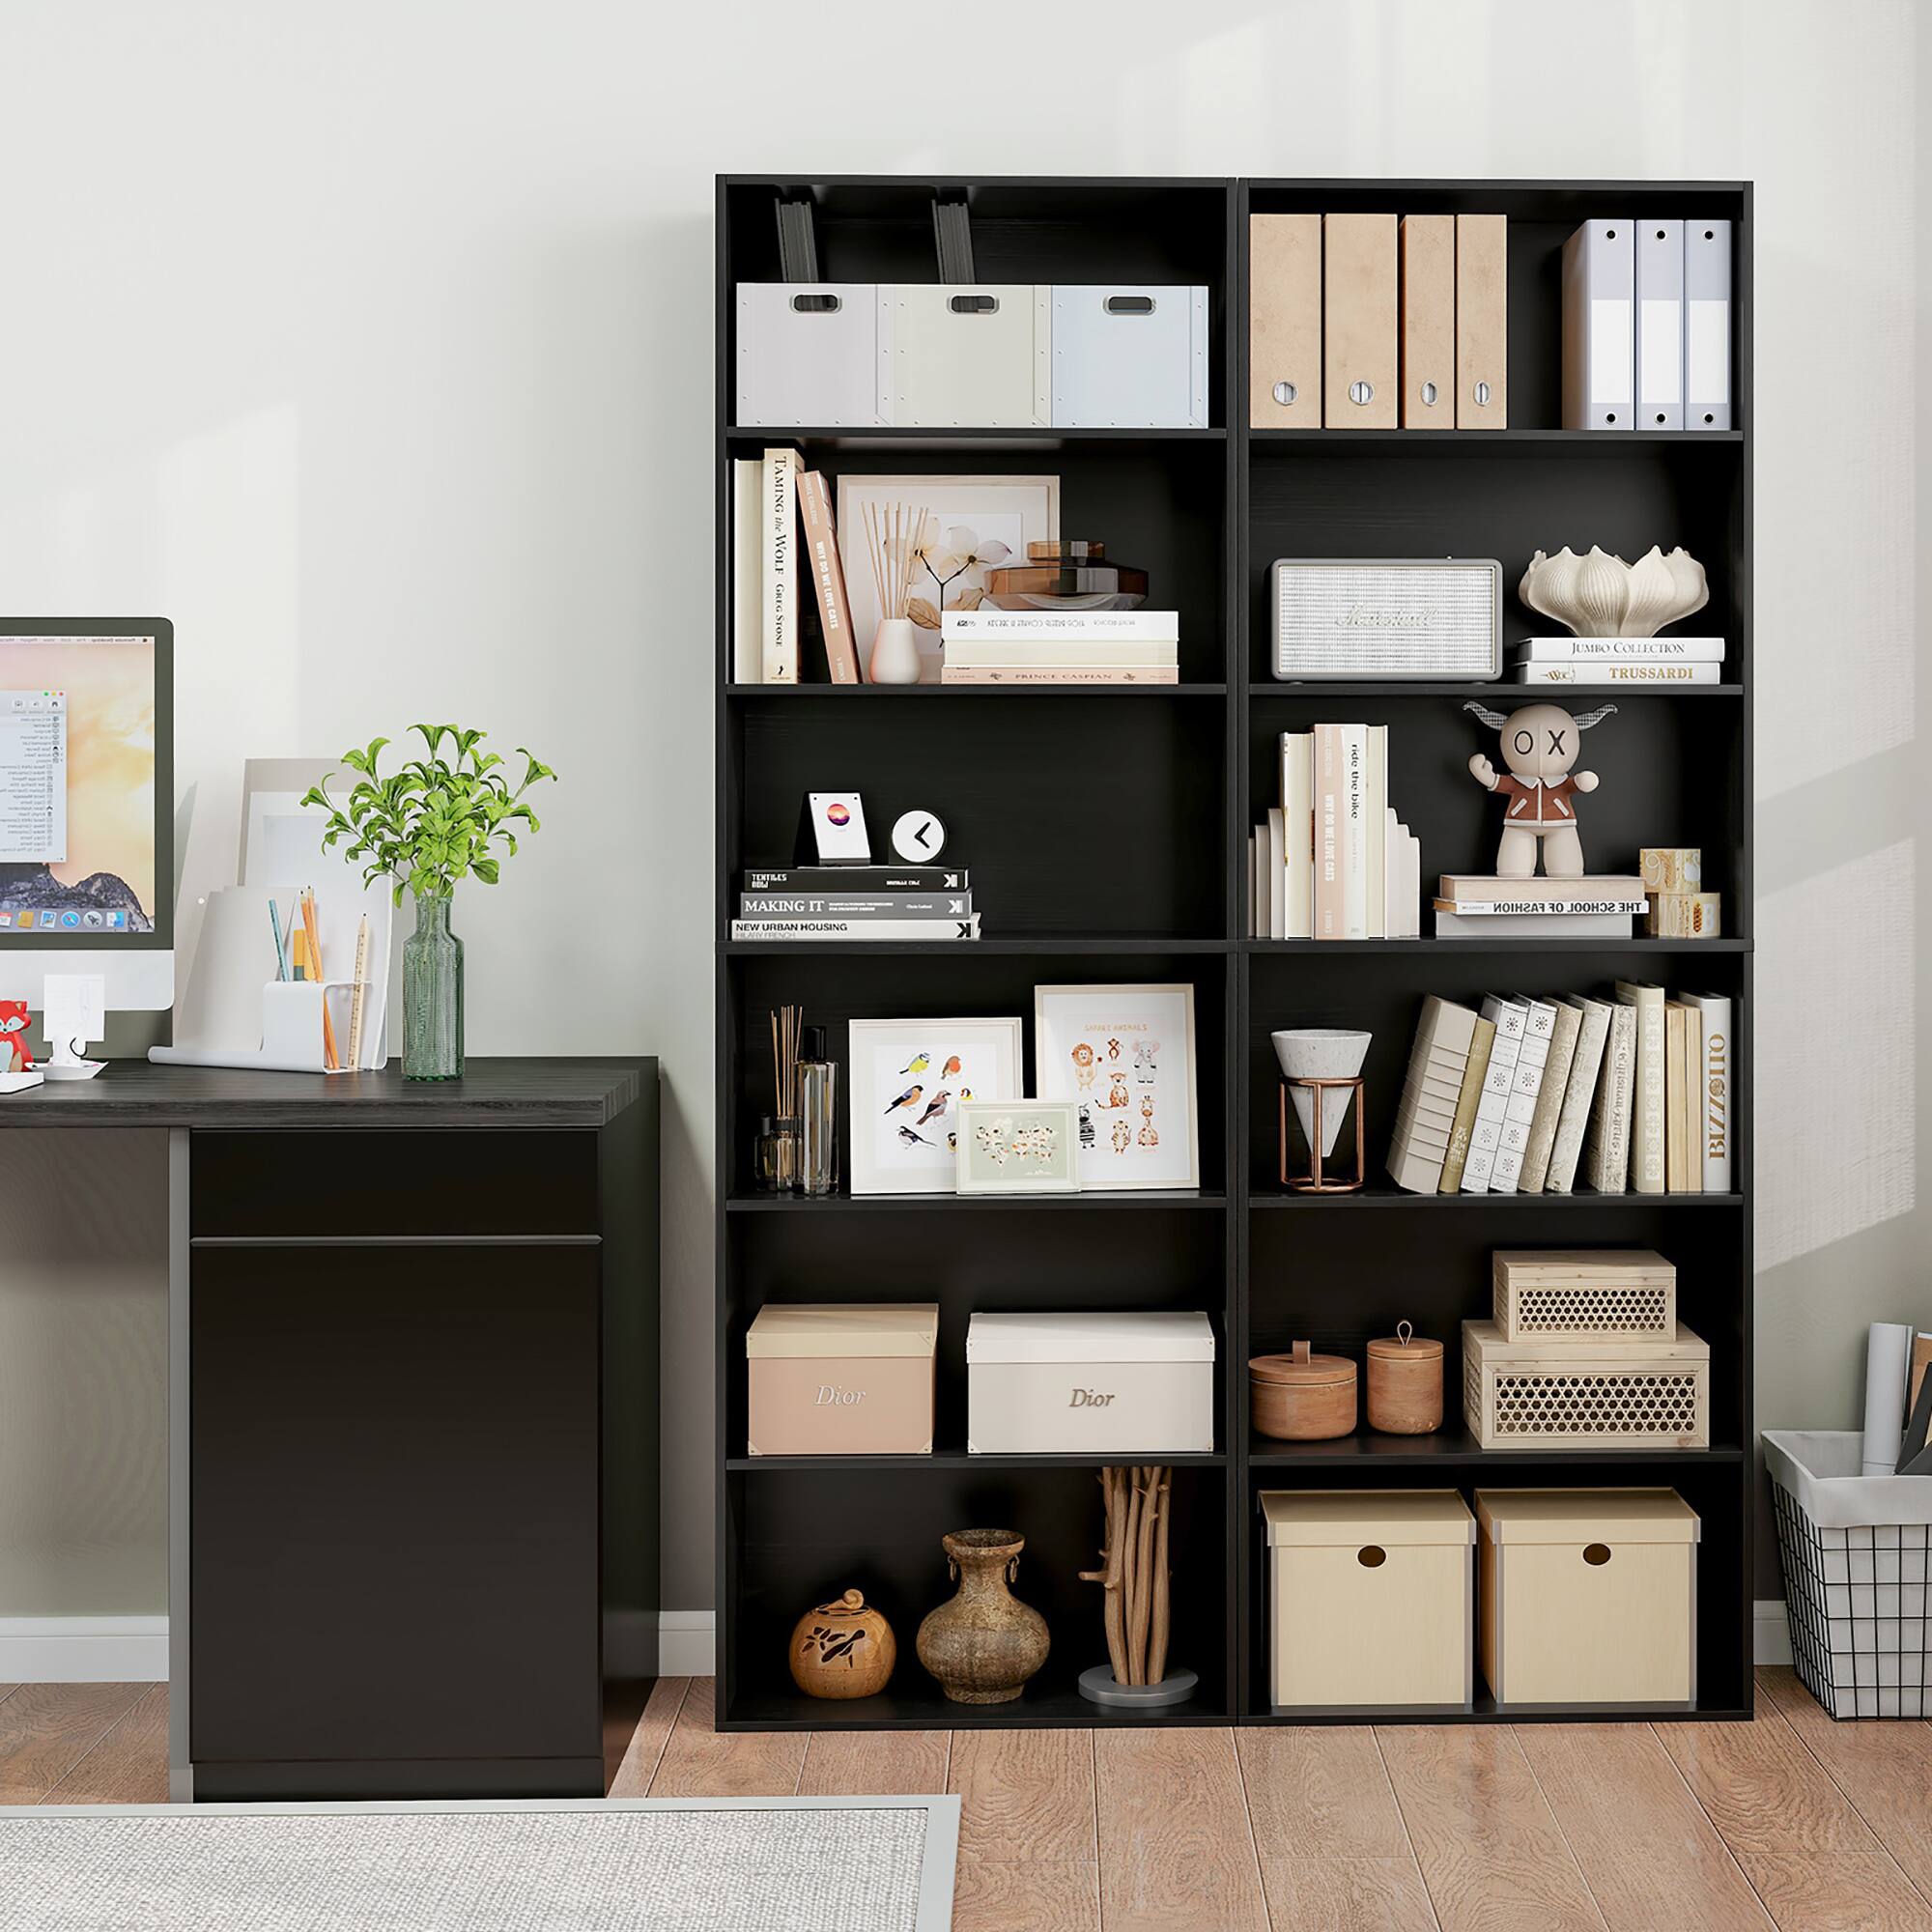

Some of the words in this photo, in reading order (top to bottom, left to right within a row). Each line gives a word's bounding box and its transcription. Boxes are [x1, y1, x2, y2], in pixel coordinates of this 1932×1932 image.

[774, 456, 787, 513] TAMING
[774, 517, 785, 532] the
[774, 534, 787, 576] WOLF
[815, 541, 827, 559] WHY
[828, 609, 838, 629] CATS
[775, 583, 785, 612] GREG
[775, 614, 786, 647] STONE
[1572, 642, 1609, 656] JUMBO
[1609, 668, 1693, 680] TRUSSARDI
[1350, 744, 1359, 767] ride
[1350, 771, 1360, 790] the
[1324, 794, 1335, 812] WHY
[1350, 793, 1360, 819] bike
[1324, 861, 1335, 881] CATS
[745, 899, 805, 912] MAKING
[809, 899, 825, 912] IT
[736, 923, 760, 931] NEW
[762, 923, 798, 931] URBAN
[800, 923, 848, 931] HOUSING
[813, 1384, 867, 1406] Dior
[1068, 1388, 1116, 1407] Dior
